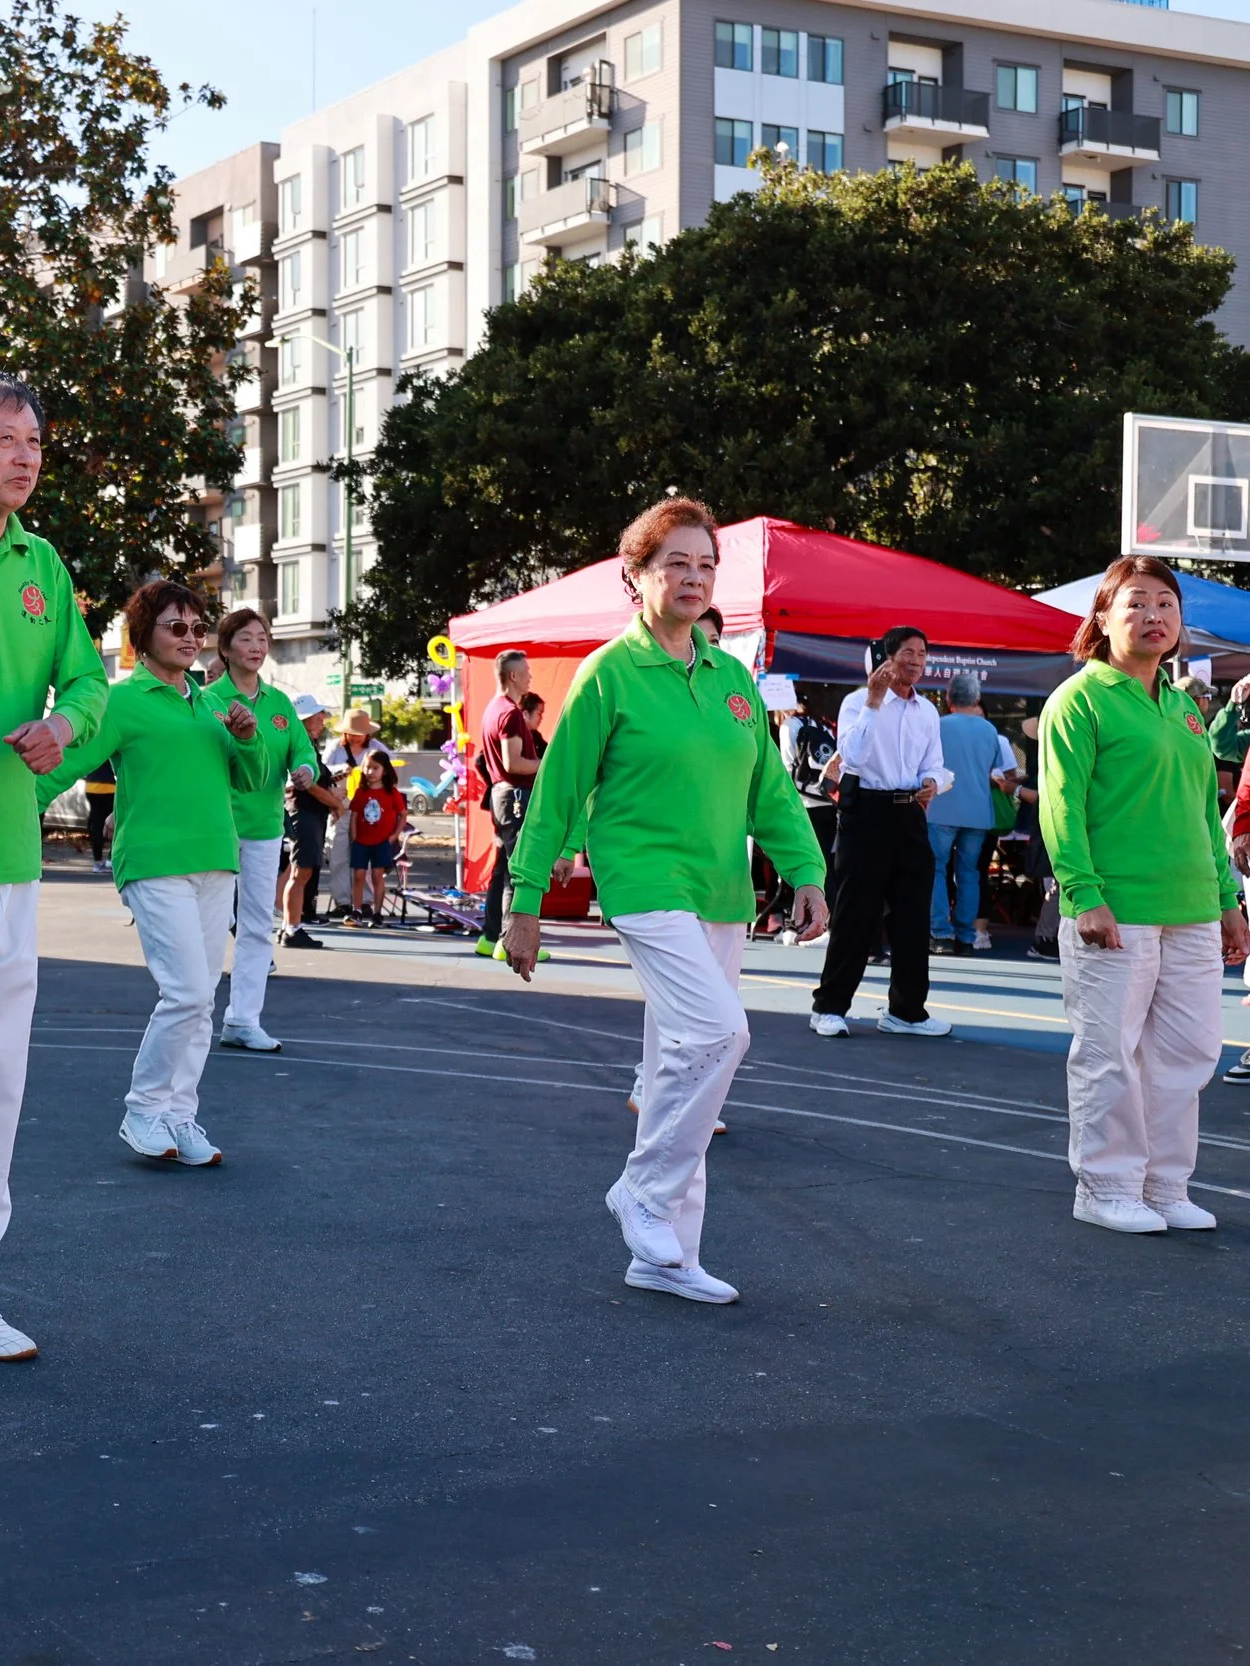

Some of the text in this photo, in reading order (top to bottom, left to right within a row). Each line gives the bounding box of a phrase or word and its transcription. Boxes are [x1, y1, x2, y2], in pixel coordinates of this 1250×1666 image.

[926, 654, 998, 667] dependent Baptist Church
